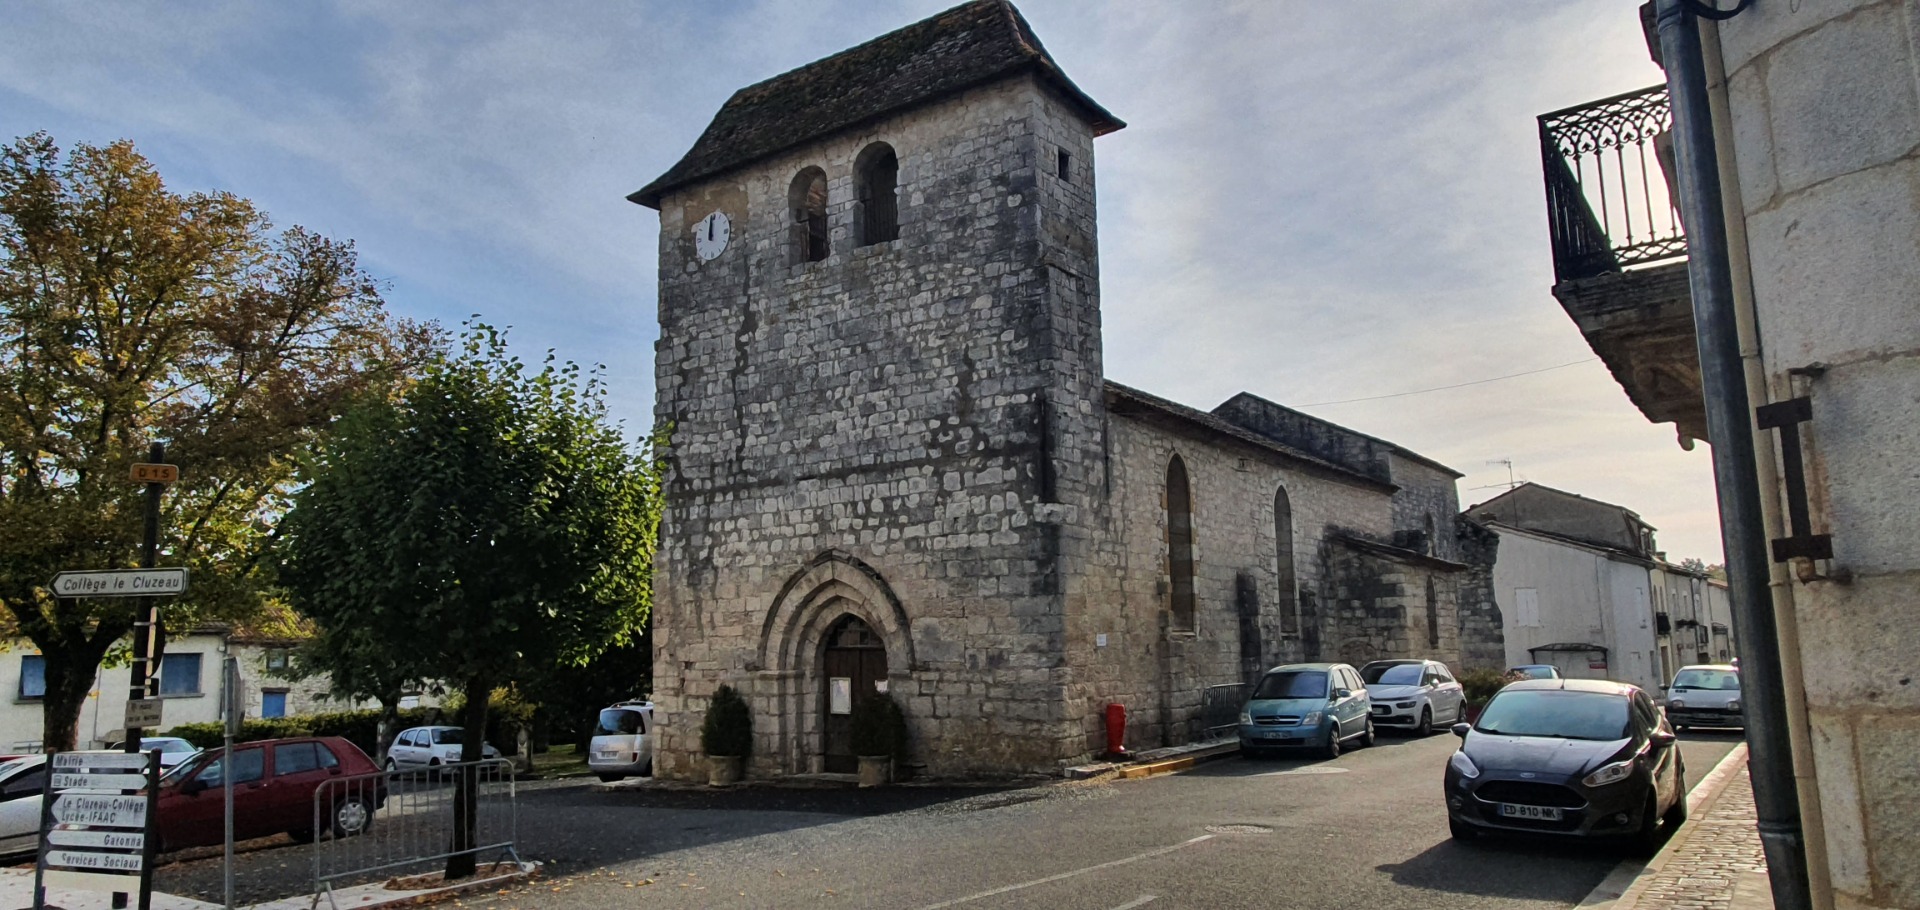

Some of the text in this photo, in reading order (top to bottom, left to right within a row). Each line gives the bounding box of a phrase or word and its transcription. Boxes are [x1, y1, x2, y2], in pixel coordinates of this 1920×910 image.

[139, 467, 170, 479] D 15
[64, 575, 179, 592] Collège le Cluzeau
[63, 775, 88, 787] Stade
[63, 797, 72, 809] Le
[103, 834, 142, 847] Garonna
[61, 852, 140, 868] Services Sociaux
